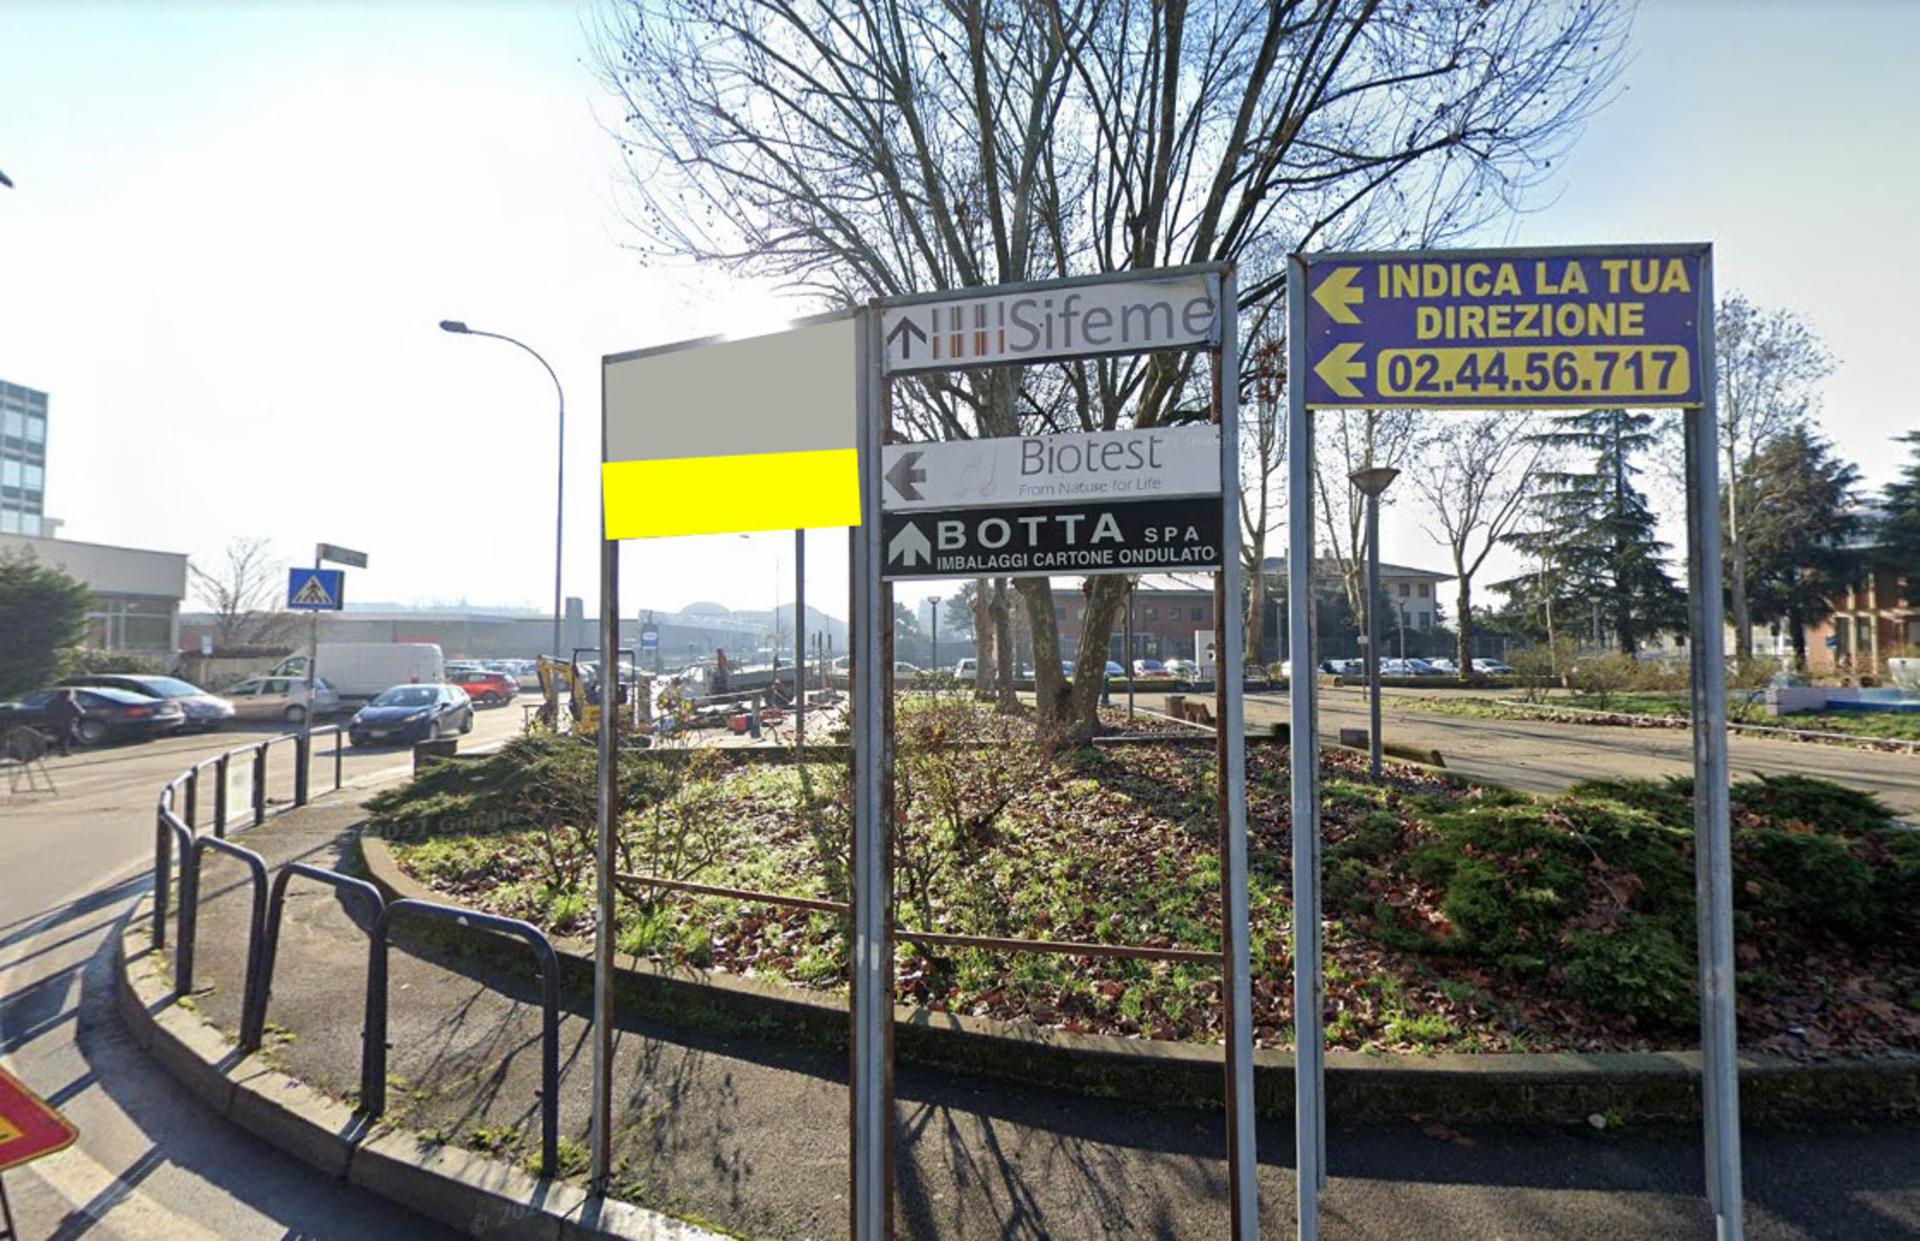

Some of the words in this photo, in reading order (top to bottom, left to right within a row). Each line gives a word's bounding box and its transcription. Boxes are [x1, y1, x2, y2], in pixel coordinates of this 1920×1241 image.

[1378, 261, 1523, 299] INDICA
[1535, 260, 1589, 297] LA
[1601, 258, 1692, 295] TUA
[1008, 293, 1215, 353] Sifeme
[1416, 302, 1646, 340] DIREZIONE
[1387, 350, 1679, 393] 02.44.56.717
[1020, 434, 1164, 476] Biotest
[1018, 482, 1055, 497] From
[1058, 481, 1108, 496] Nature
[1112, 478, 1131, 492] for
[1135, 476, 1162, 491] Life
[937, 512, 1125, 551] BOTTA
[1143, 525, 1200, 543] SPA
[936, 552, 1029, 571] IMBALAGGI
[1032, 549, 1113, 568] CARTONE
[1118, 545, 1216, 564] ONDULATO
